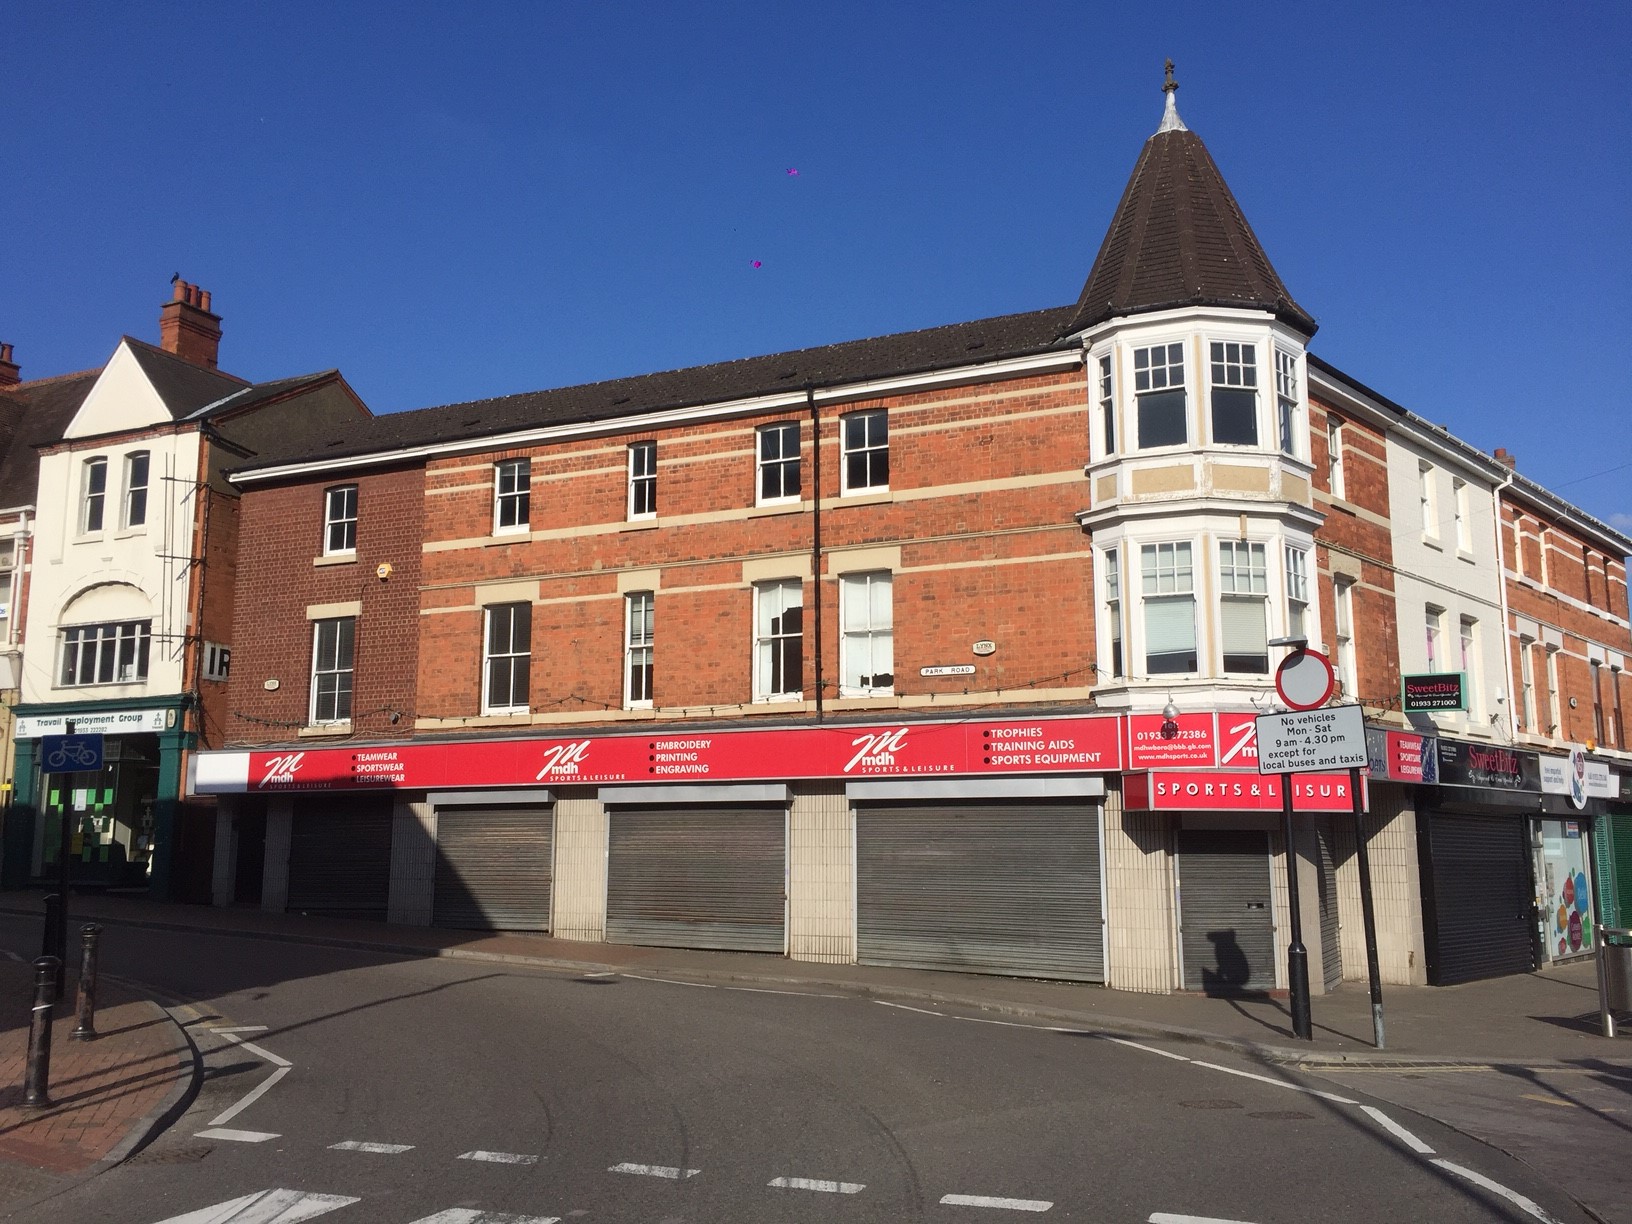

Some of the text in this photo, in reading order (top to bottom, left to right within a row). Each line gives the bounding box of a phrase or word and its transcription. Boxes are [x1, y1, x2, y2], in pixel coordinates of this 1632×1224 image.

[1407, 683, 1459, 694] SweetBitz
[36, 717, 62, 727] Travail
[118, 713, 143, 723] Group
[1281, 713, 1336, 726] No vehicles
[991, 728, 1043, 739] TROPHIES
[1137, 730, 1207, 740] 01933 272386
[1287, 727, 1307, 736] Mon
[1314, 724, 1332, 733] Sat
[656, 740, 712, 750] EMBROIDERY
[1304, 735, 1328, 745] 4.30
[1330, 734, 1345, 743] pm
[991, 740, 1075, 752] TRAINING AIDS
[357, 752, 398, 761] TEAMWEAR
[655, 752, 698, 762] PRINTING
[1268, 748, 1300, 759] except
[1302, 747, 1316, 756] for
[861, 752, 895, 766] mdh
[991, 752, 1101, 766] SPORTS EQUIPMENT
[1263, 754, 1364, 770] local buses and taxis
[1469, 745, 1518, 774] SweetBitz
[356, 763, 405, 773] SPORTSWEAR
[551, 762, 579, 775] mdh
[655, 764, 710, 774] ENGRAVING
[271, 773, 294, 784] mdh
[356, 774, 405, 783] LEISUREWEAR
[1268, 784, 1346, 797] LISUR
